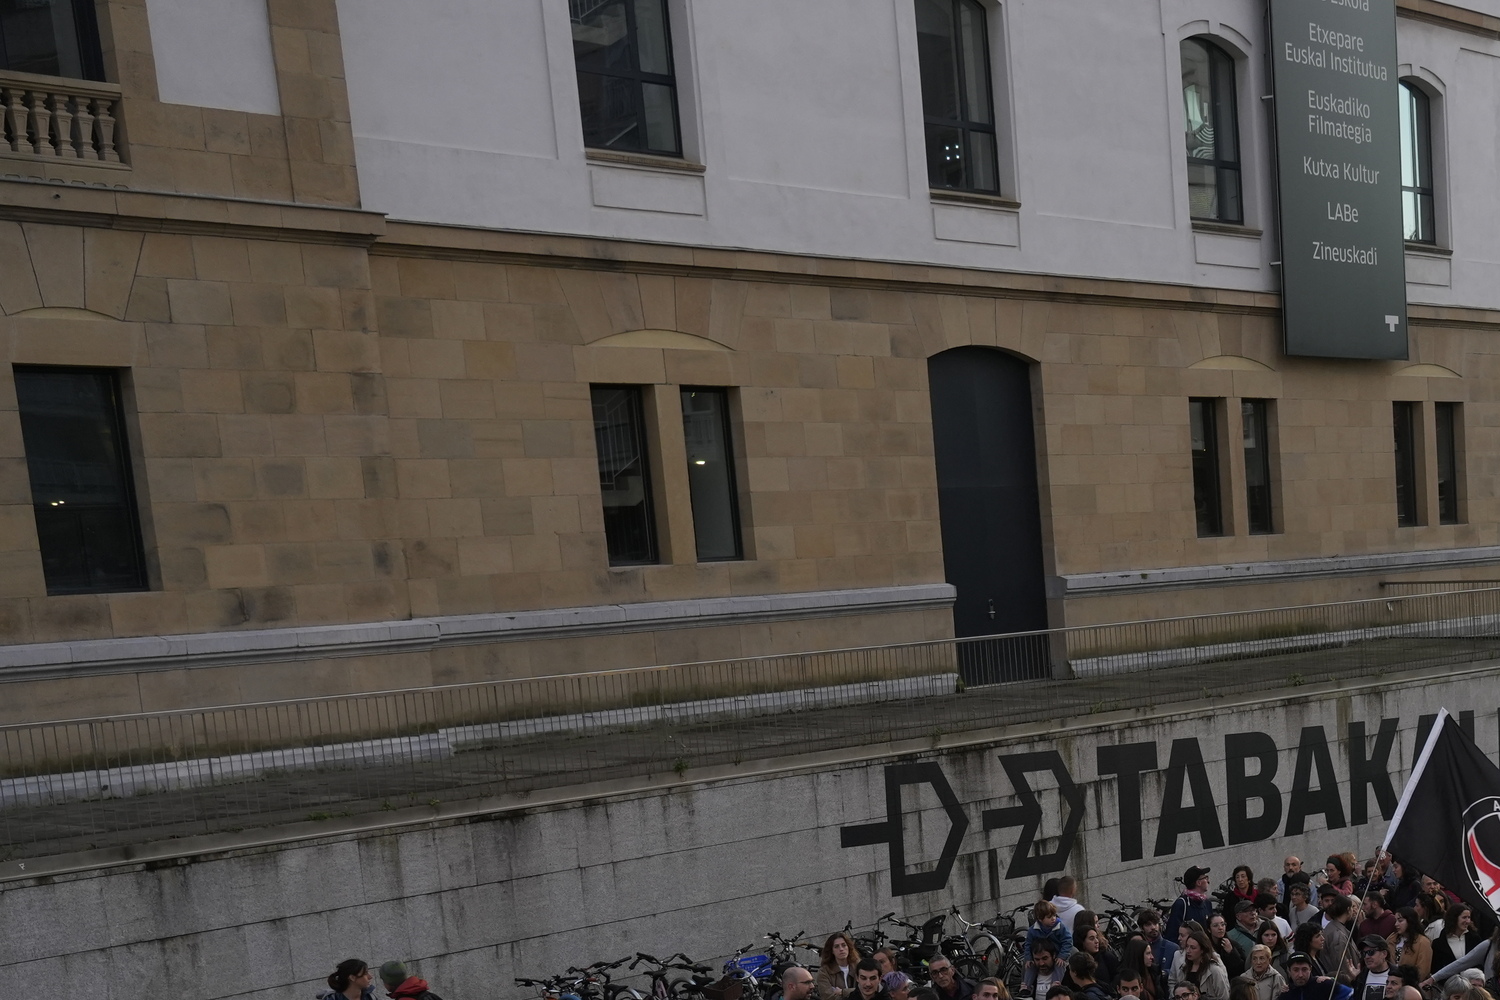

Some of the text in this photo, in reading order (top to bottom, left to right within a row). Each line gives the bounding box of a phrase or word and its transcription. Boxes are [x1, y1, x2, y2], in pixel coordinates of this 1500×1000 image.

[1331, 0, 1370, 12] skola
[1309, 22, 1364, 52] Etxepare
[1285, 42, 1388, 82] Euskal Institutua
[1308, 90, 1371, 119] Euskadiko
[1308, 115, 1372, 145] Filmategia
[1303, 156, 1380, 185] Kutxa Kultur
[1327, 202, 1359, 223] LABe
[1312, 241, 1378, 266] Zineuskadi
